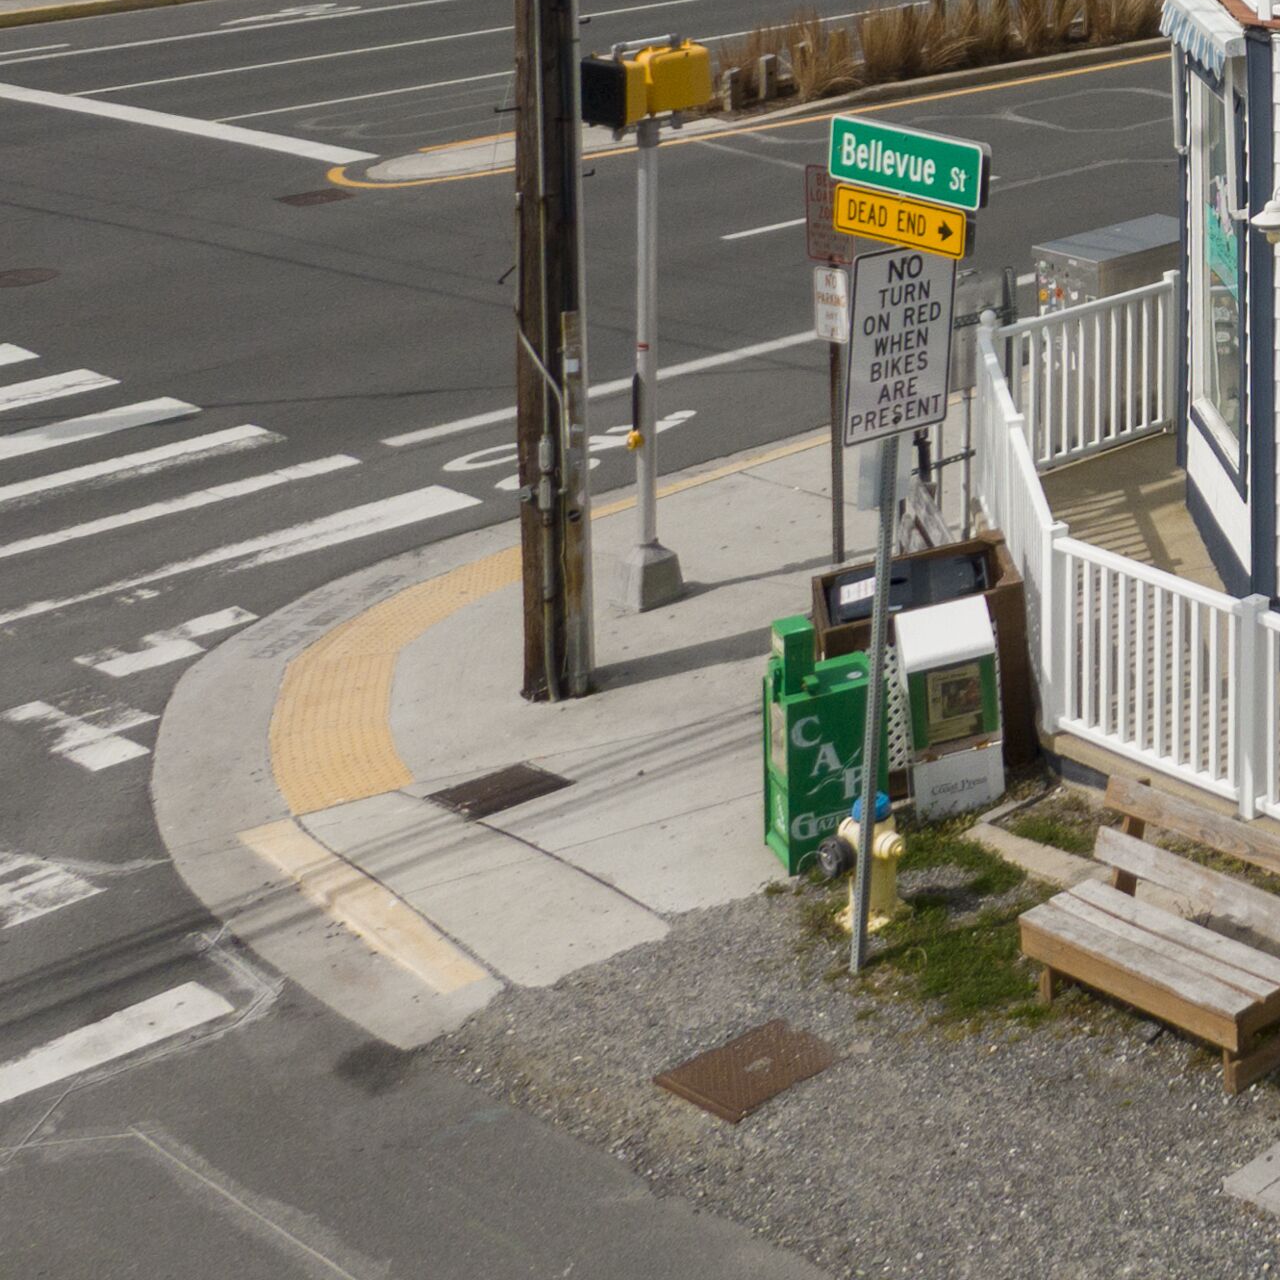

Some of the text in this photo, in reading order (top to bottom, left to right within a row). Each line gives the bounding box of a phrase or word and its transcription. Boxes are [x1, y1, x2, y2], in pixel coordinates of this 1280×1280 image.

[841, 132, 967, 193] Bellevue St
[847, 198, 927, 237] DEAD END
[825, 273, 838, 289] NO
[889, 254, 923, 284] NO
[879, 280, 931, 307] TURN
[864, 313, 894, 336] ON
[904, 302, 941, 326] RED
[875, 332, 929, 358] WHEN
[870, 355, 929, 384] BIKES
[878, 380, 918, 404] ARE
[850, 393, 942, 437] PRESENT
